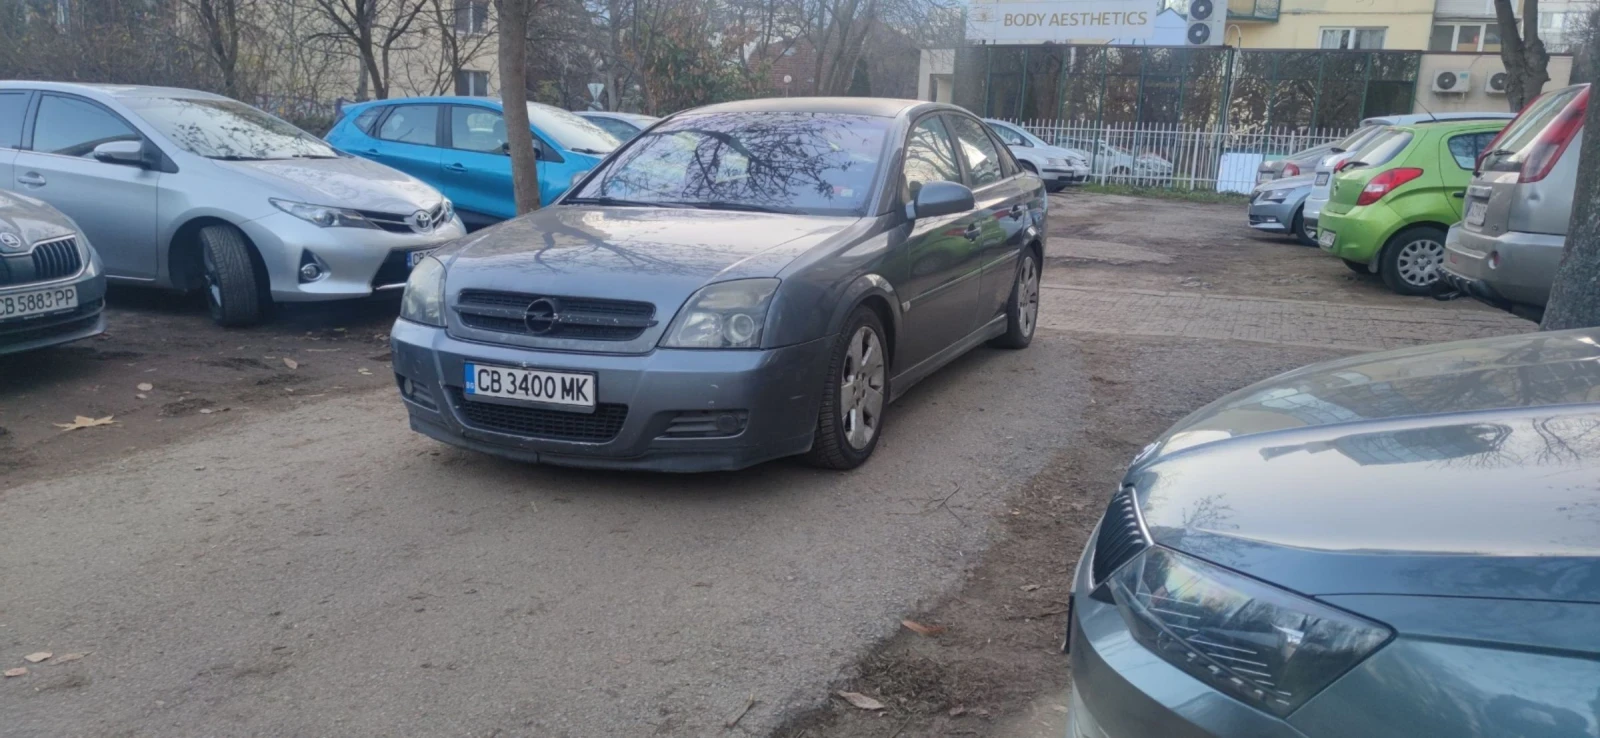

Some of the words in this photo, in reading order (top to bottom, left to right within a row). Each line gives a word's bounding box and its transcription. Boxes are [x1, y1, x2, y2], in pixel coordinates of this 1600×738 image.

[1003, 13, 1046, 27] BODY
[1048, 11, 1148, 27] AESTHETICS
[17, 291, 53, 313] 5883
[54, 288, 75, 306] PP
[477, 368, 502, 394] CB
[506, 371, 556, 399] 3400
[561, 376, 589, 402] MK
